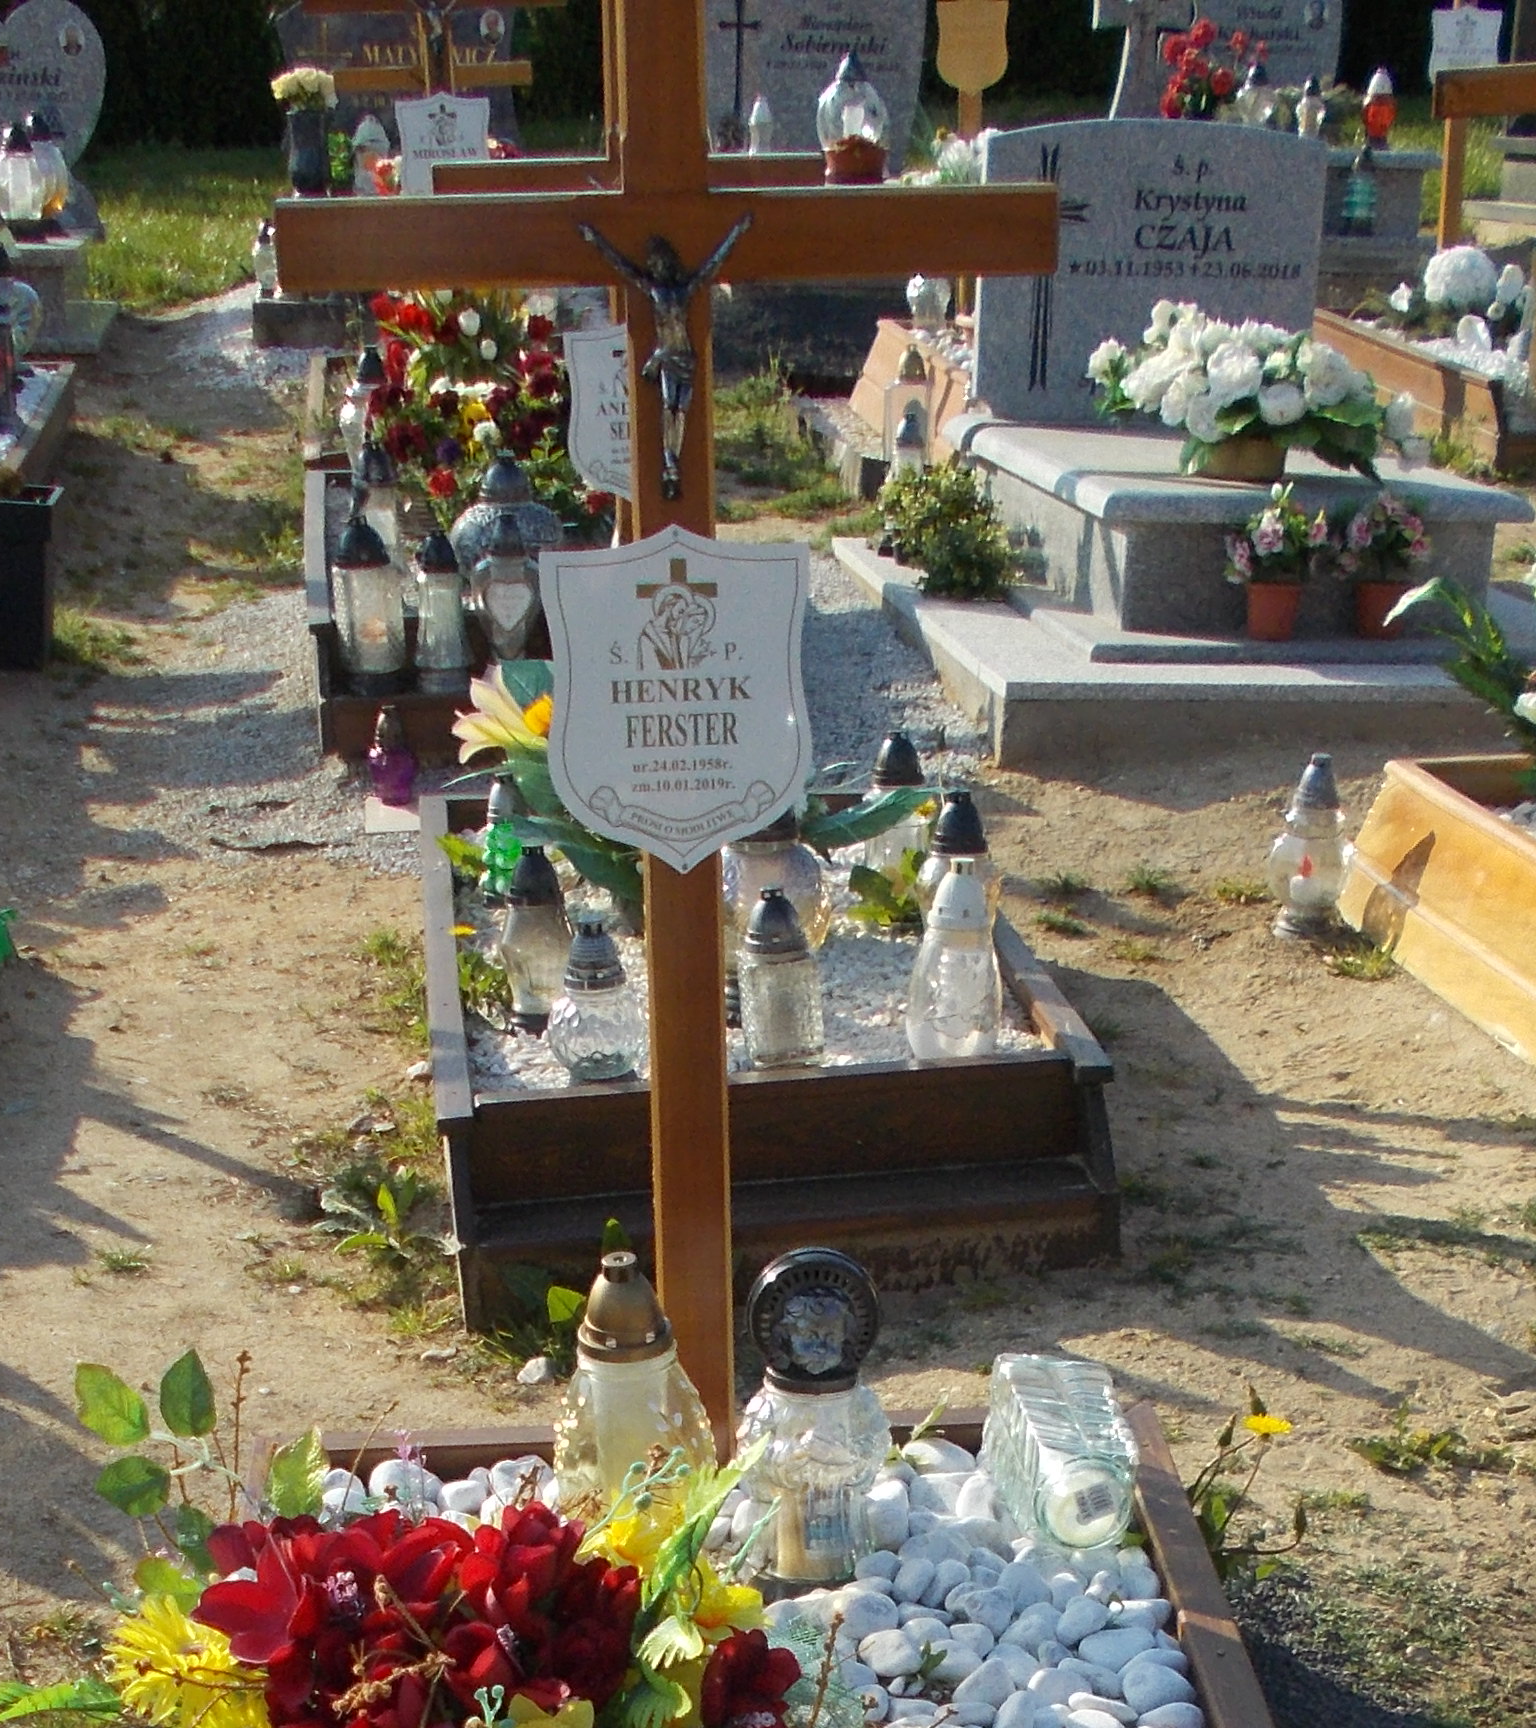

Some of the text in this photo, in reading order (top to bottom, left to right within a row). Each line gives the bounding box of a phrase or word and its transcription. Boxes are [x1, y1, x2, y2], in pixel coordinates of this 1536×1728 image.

[1134, 188, 1247, 221] Krystyna
[1134, 222, 1235, 259] CZAJA
[610, 675, 754, 706] HENRYK
[625, 711, 740, 749] FERSTER
[632, 757, 734, 774] ur.24.02.1958r.
[631, 777, 737, 794] zm.10.01.2019r.
